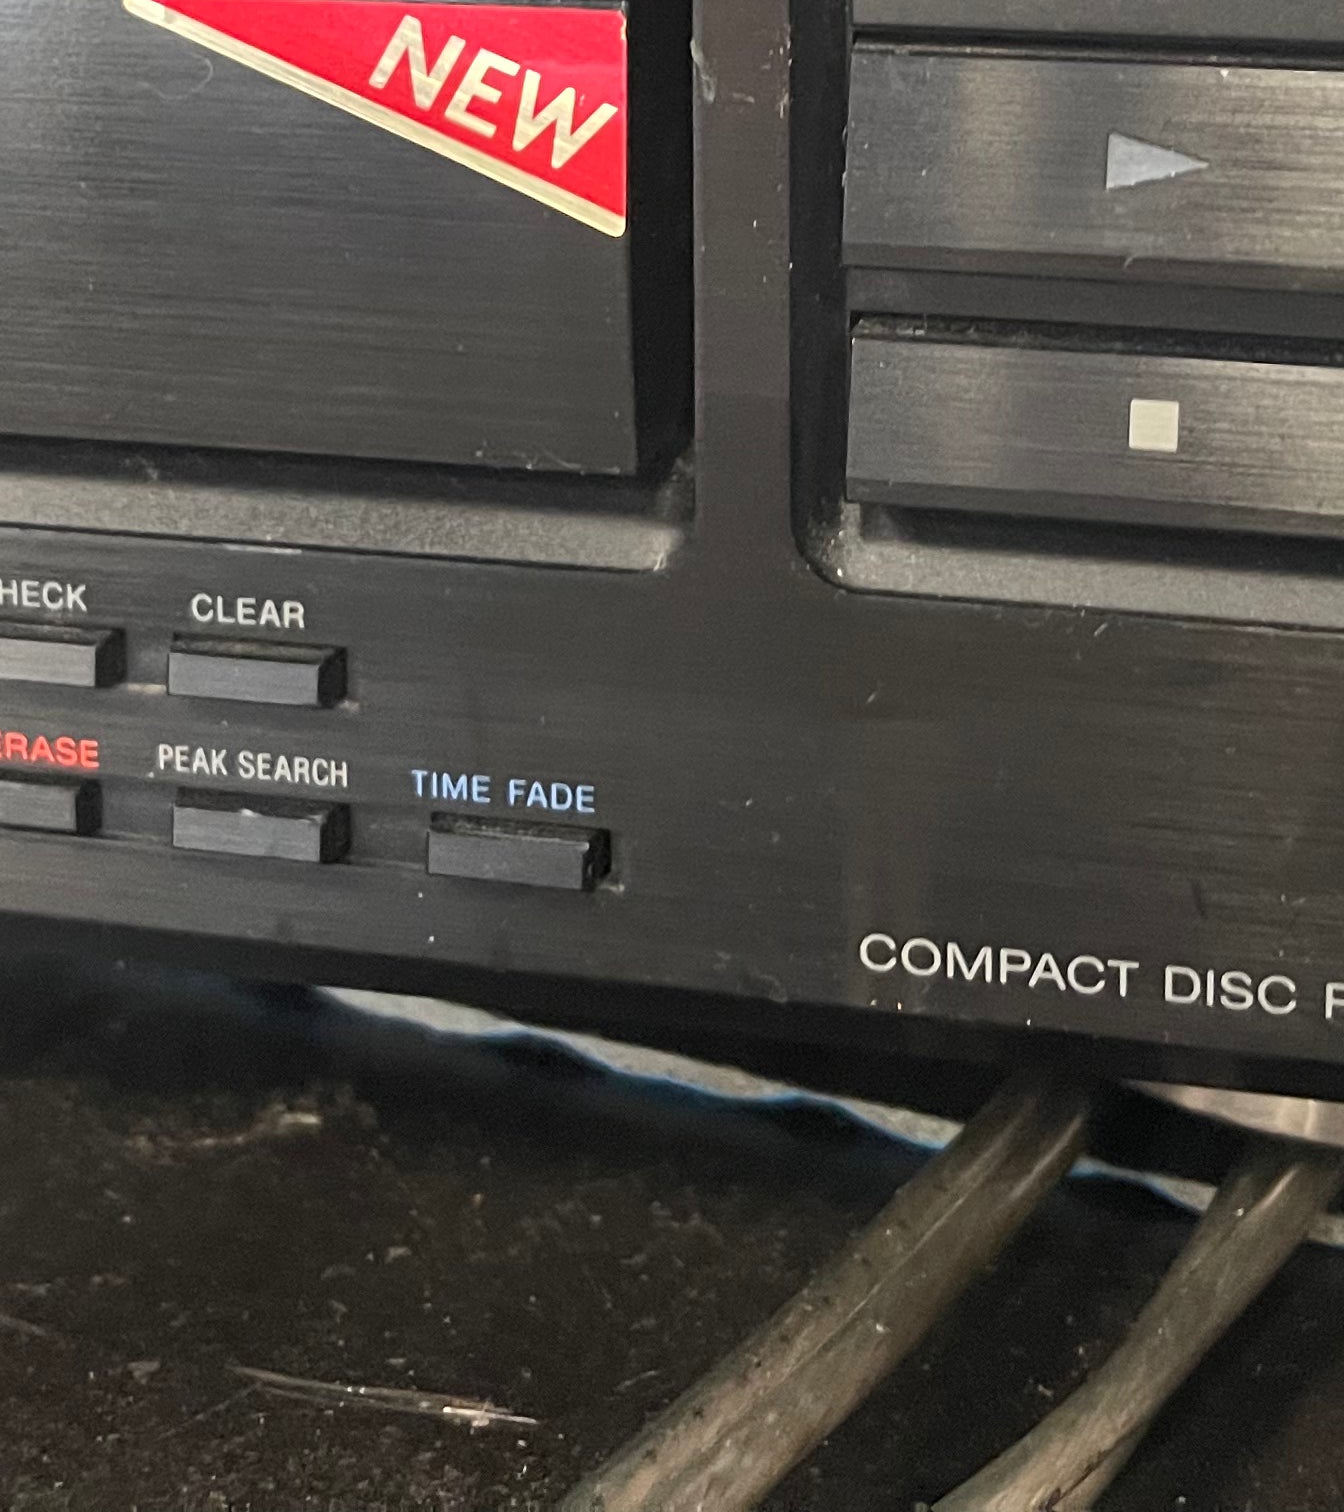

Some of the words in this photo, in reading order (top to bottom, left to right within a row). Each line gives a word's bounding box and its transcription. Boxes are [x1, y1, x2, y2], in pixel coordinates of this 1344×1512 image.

[369, 14, 618, 169] NEW
[191, 593, 306, 630] CLEAR
[158, 744, 228, 777] PEAK
[237, 751, 349, 788] SEARCH
[412, 770, 491, 805] TIME
[507, 778, 595, 814] FADE
[858, 933, 1140, 999] COMPACT
[1163, 965, 1298, 1015] DISC
